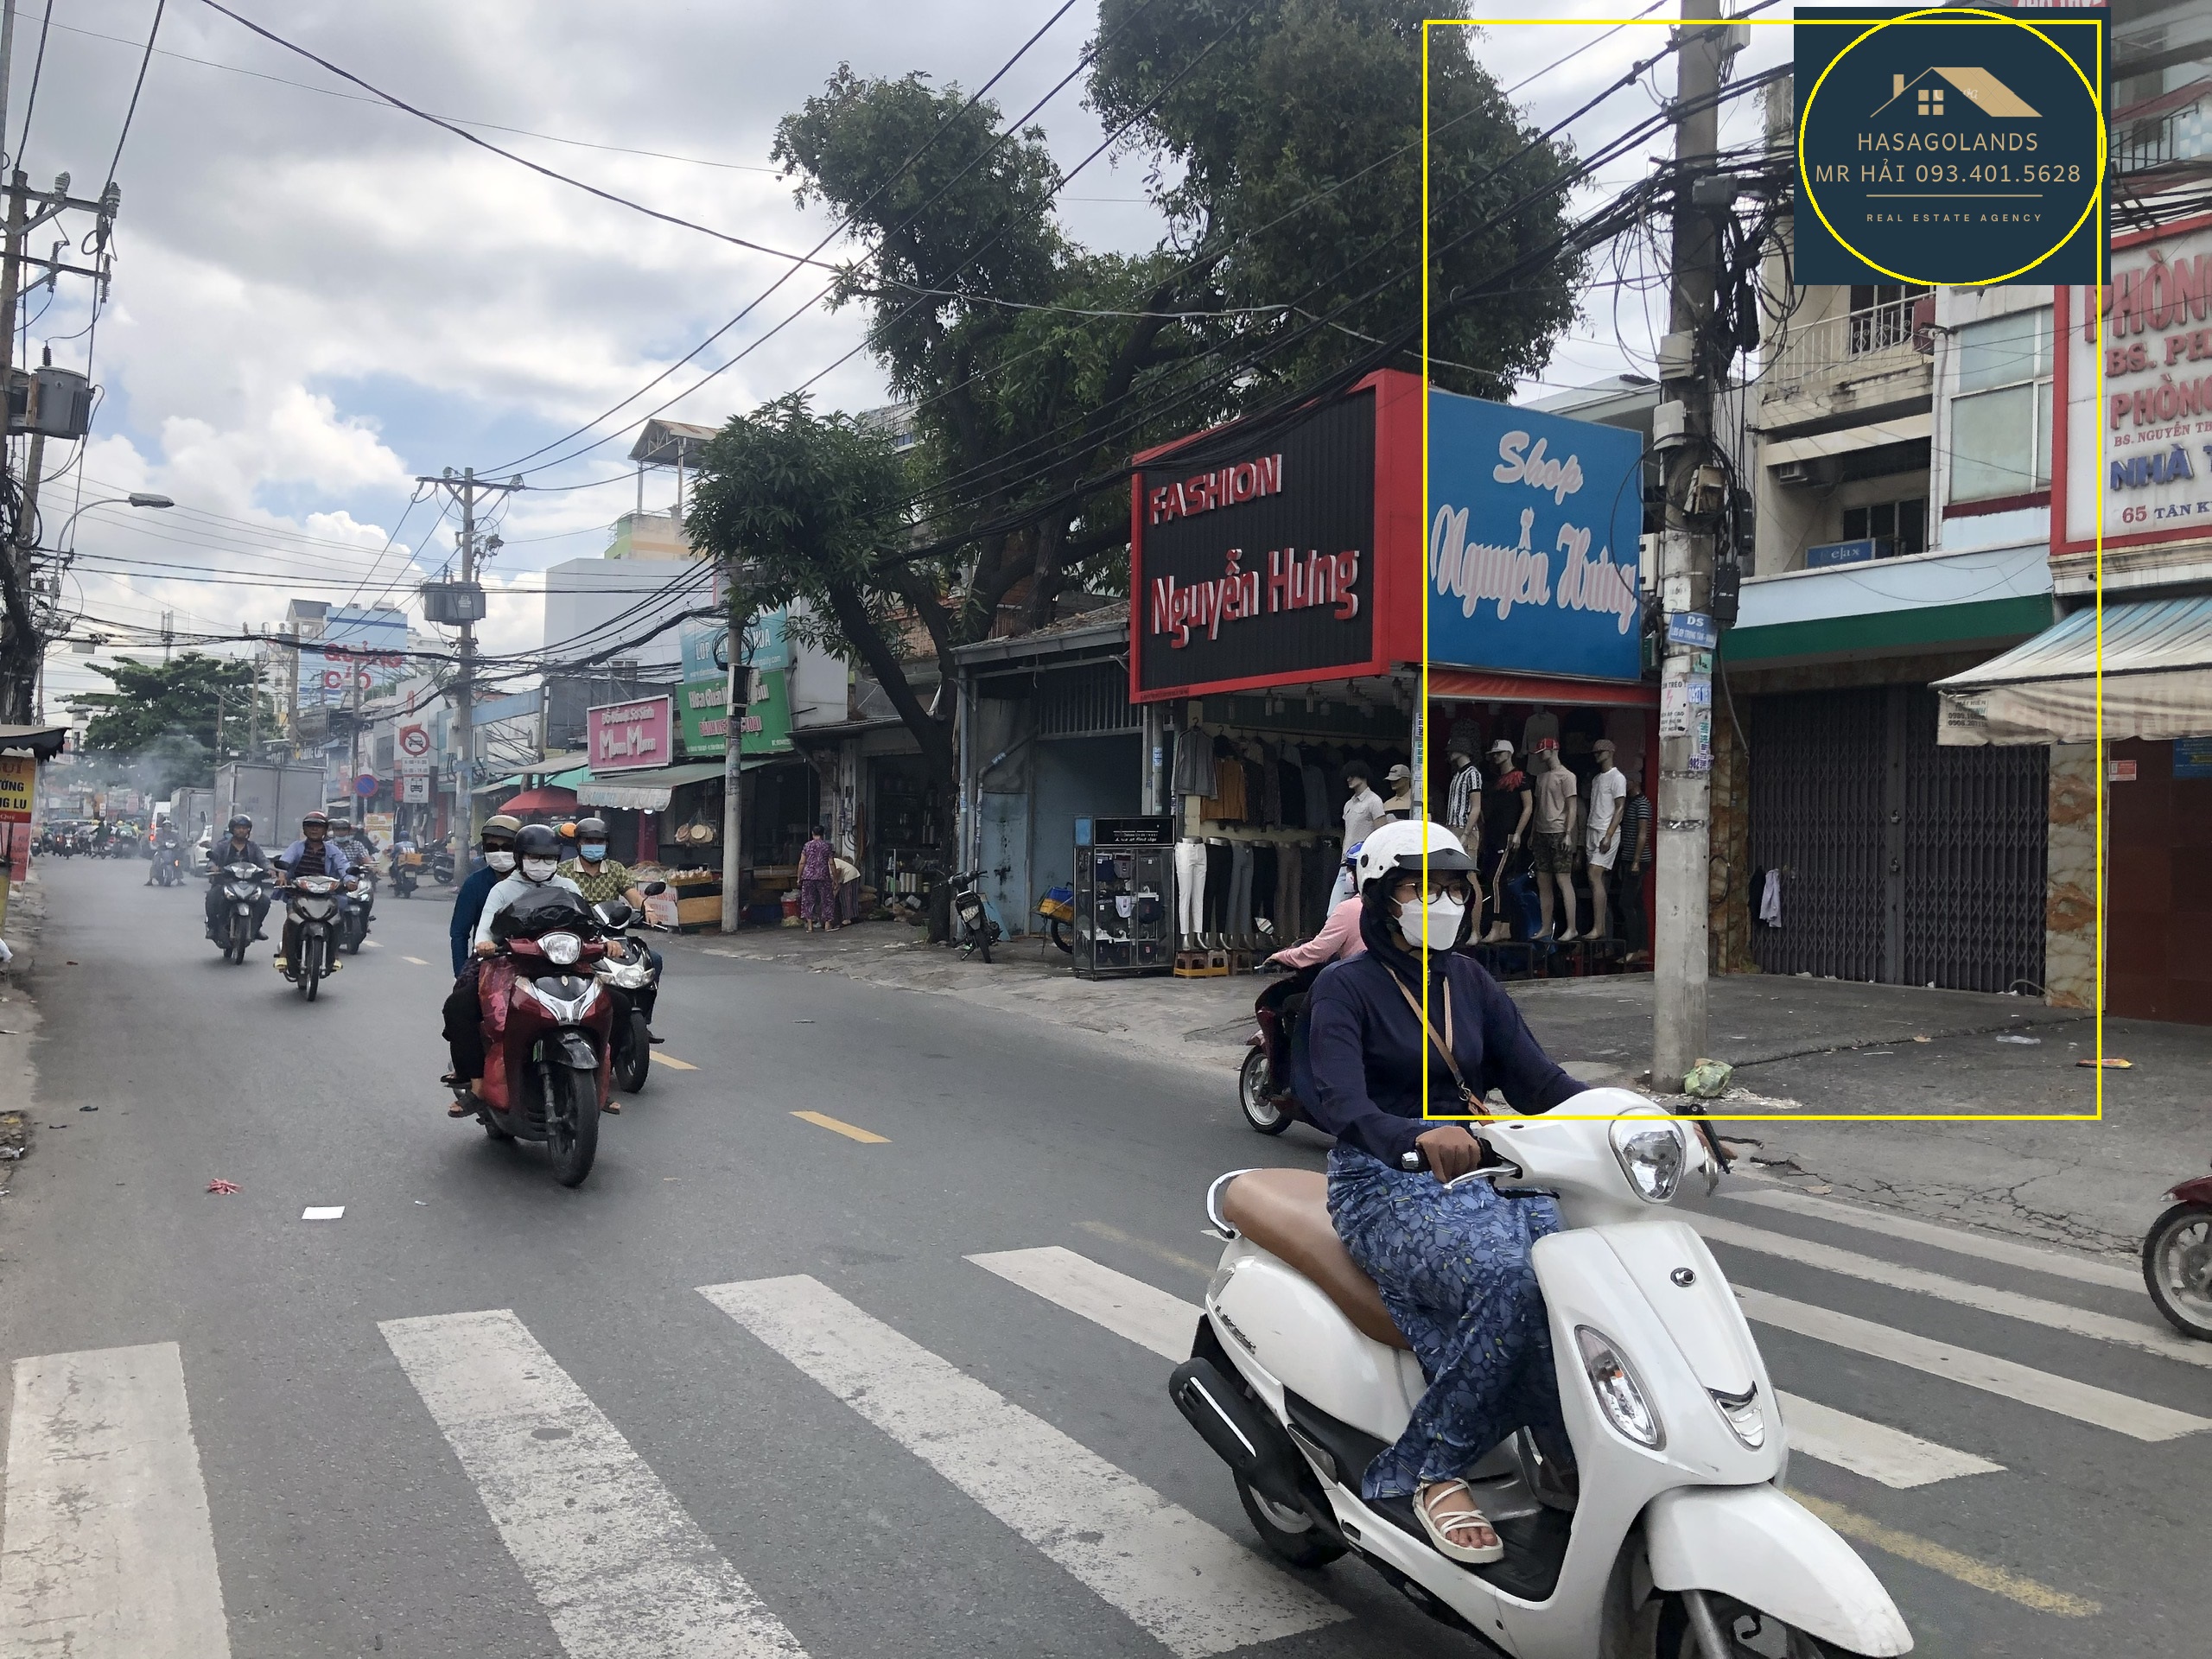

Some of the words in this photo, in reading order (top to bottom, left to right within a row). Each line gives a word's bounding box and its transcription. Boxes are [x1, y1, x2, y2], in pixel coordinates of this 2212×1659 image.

[2084, 249, 2212, 343] PHÒN
[2105, 342, 2157, 378] BS.
[2113, 435, 2134, 448] BS.
[1492, 430, 1583, 505] Shop
[2110, 443, 2195, 491] NHÀ
[1148, 454, 1282, 525] FASHION
[2122, 505, 2148, 524] 65
[2154, 504, 2191, 519] TÂN
[1151, 548, 1259, 649] Nguyễn
[1267, 547, 1360, 620] Hưng
[1687, 615, 1704, 627] DS
[14, 798, 27, 810] LU
